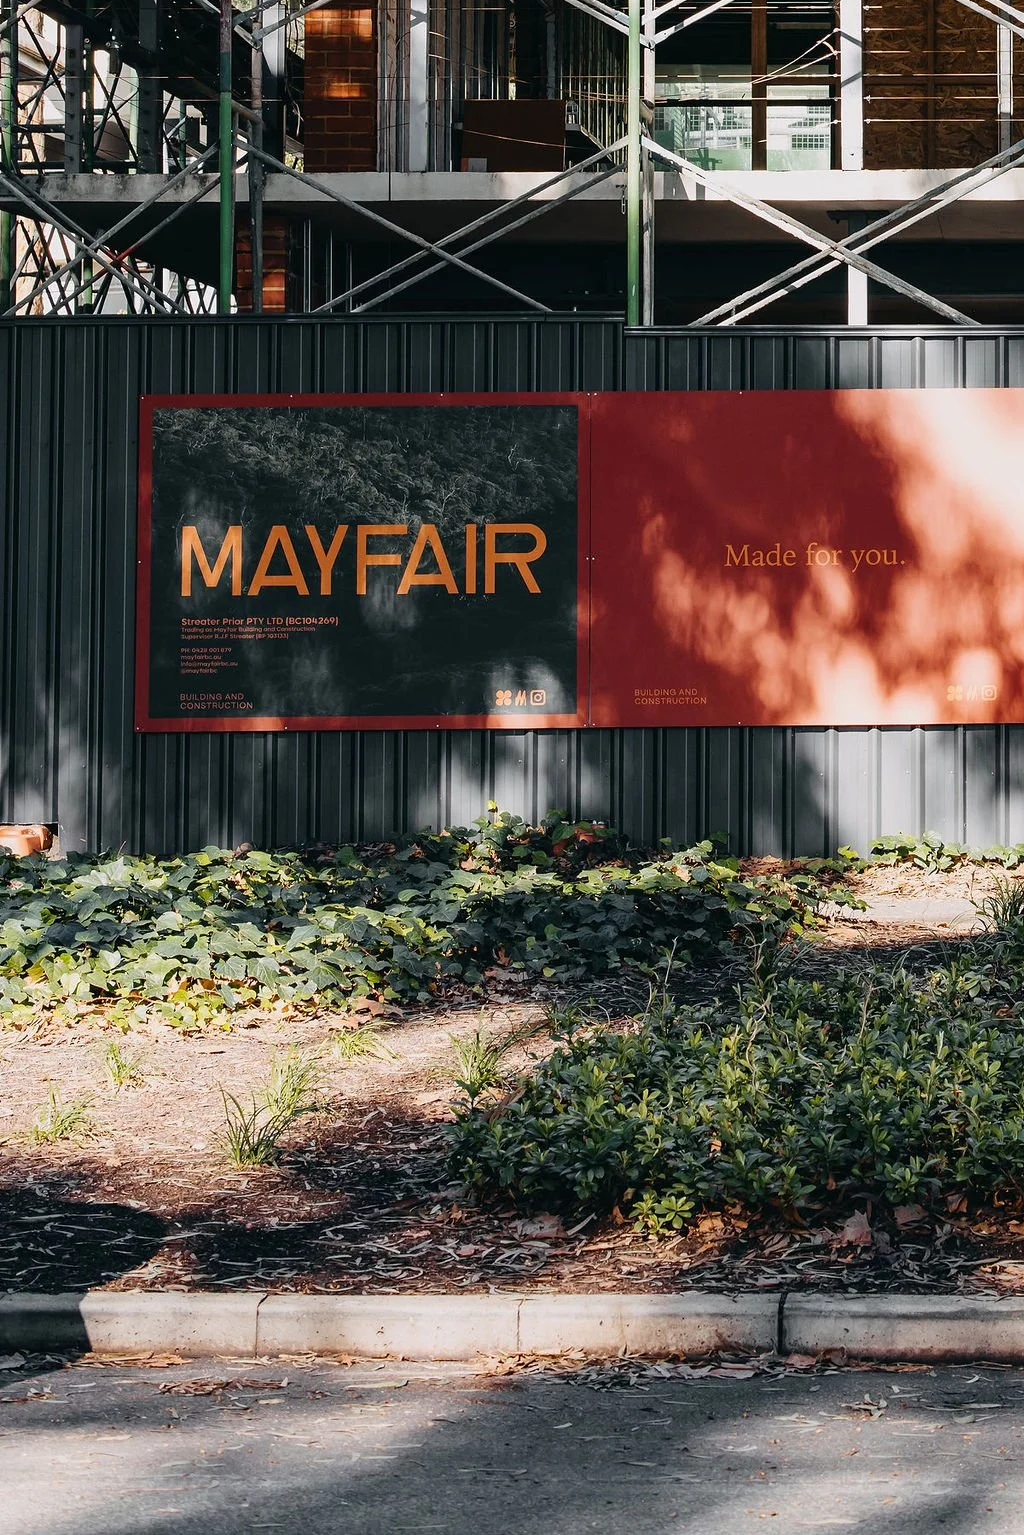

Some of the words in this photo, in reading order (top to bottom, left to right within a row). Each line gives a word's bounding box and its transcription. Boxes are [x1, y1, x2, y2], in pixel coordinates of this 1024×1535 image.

[181, 523, 547, 596] MAYFAIR
[724, 542, 797, 567] Made
[805, 542, 843, 567] for
[851, 548, 906, 573] you.
[181, 617, 220, 626] Streater
[222, 617, 244, 626] Prior
[246, 617, 264, 625] PTY
[266, 617, 284, 625] LTD
[285, 616, 339, 627] (BC104269)
[181, 626, 204, 634] Trading
[180, 693, 223, 701] BUILDING
[225, 692, 244, 700] AND
[634, 688, 677, 697] BUILDING
[679, 688, 698, 696] AND
[180, 701, 253, 710] CONSTRUCTION
[634, 697, 707, 705] CONSTRUCTION
